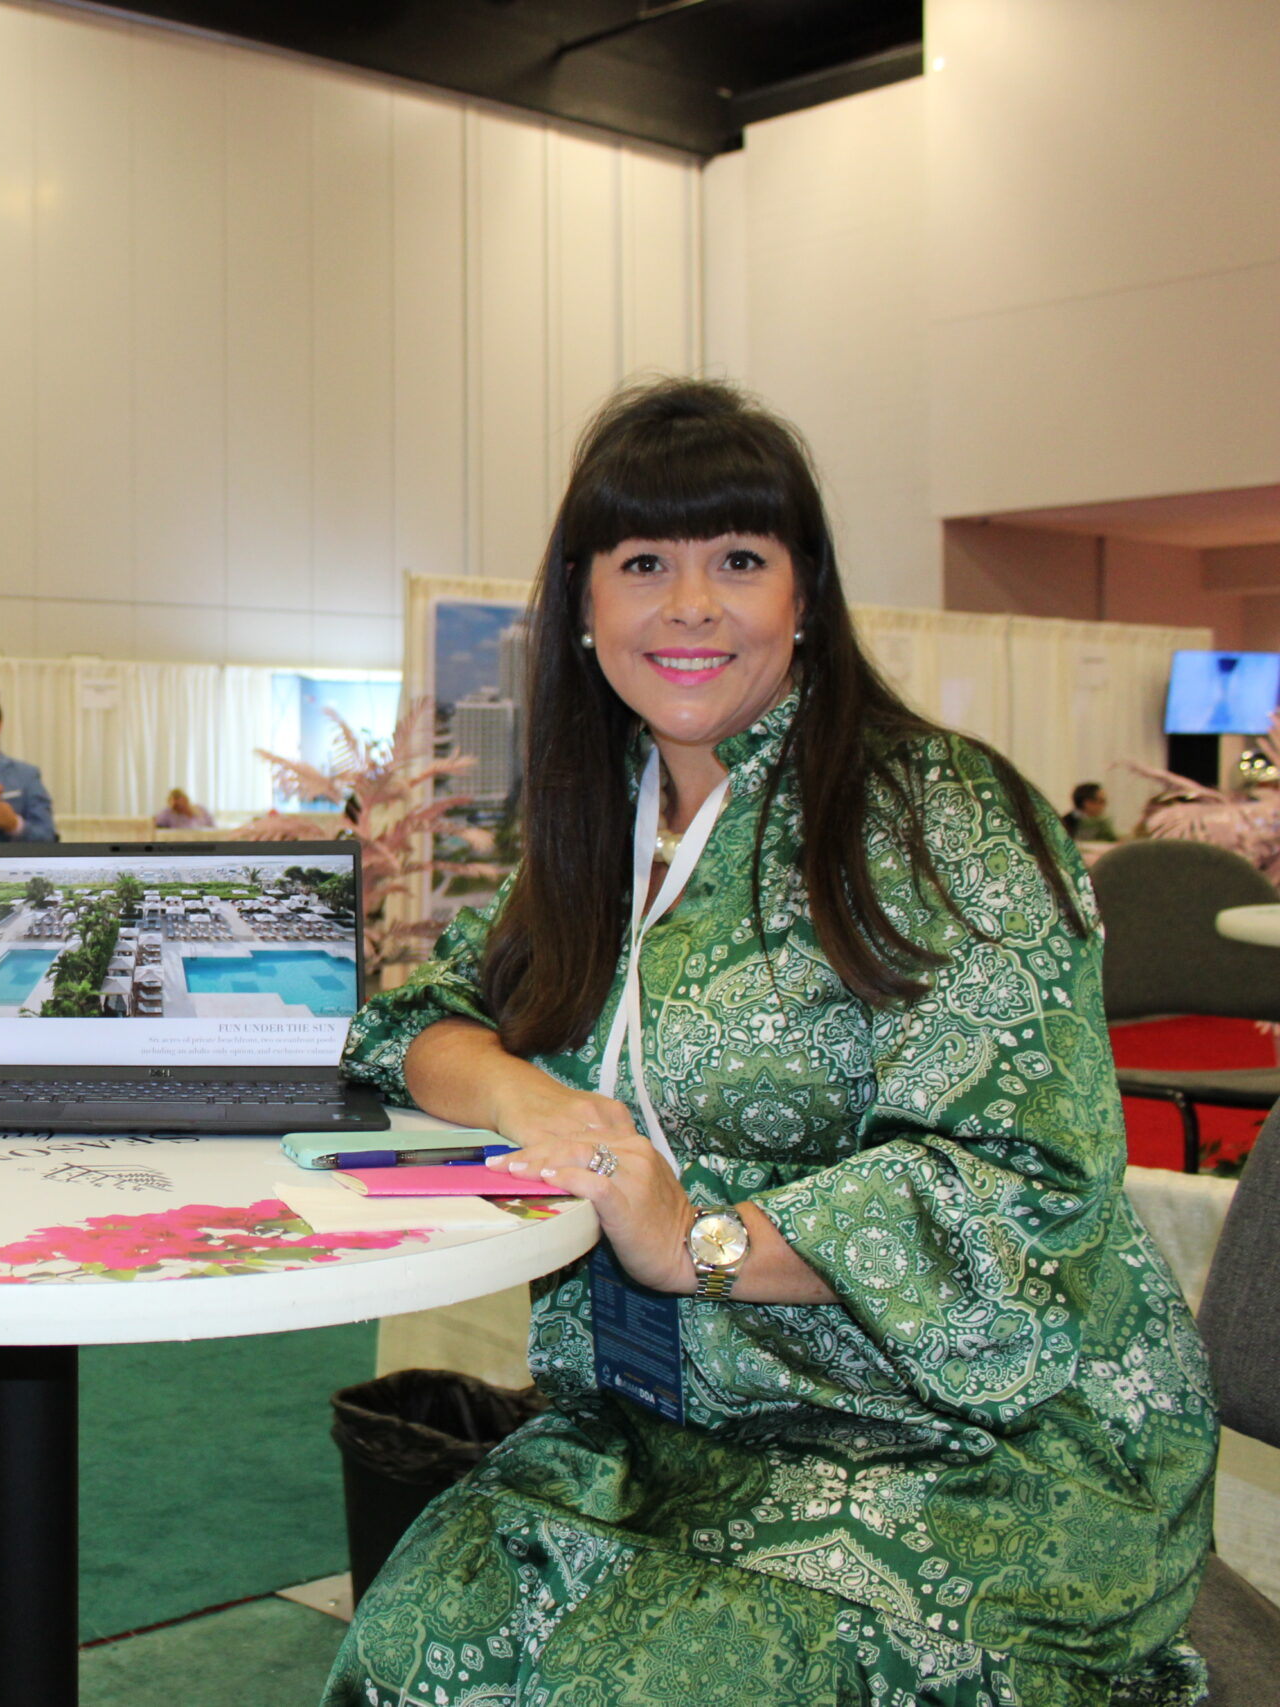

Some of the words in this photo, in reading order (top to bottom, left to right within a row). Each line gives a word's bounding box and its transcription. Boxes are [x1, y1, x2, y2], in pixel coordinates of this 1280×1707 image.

[218, 1023, 241, 1033] FUN
[244, 1023, 285, 1033] UNDER
[286, 1023, 310, 1033] THE
[312, 1023, 336, 1033] SUN
